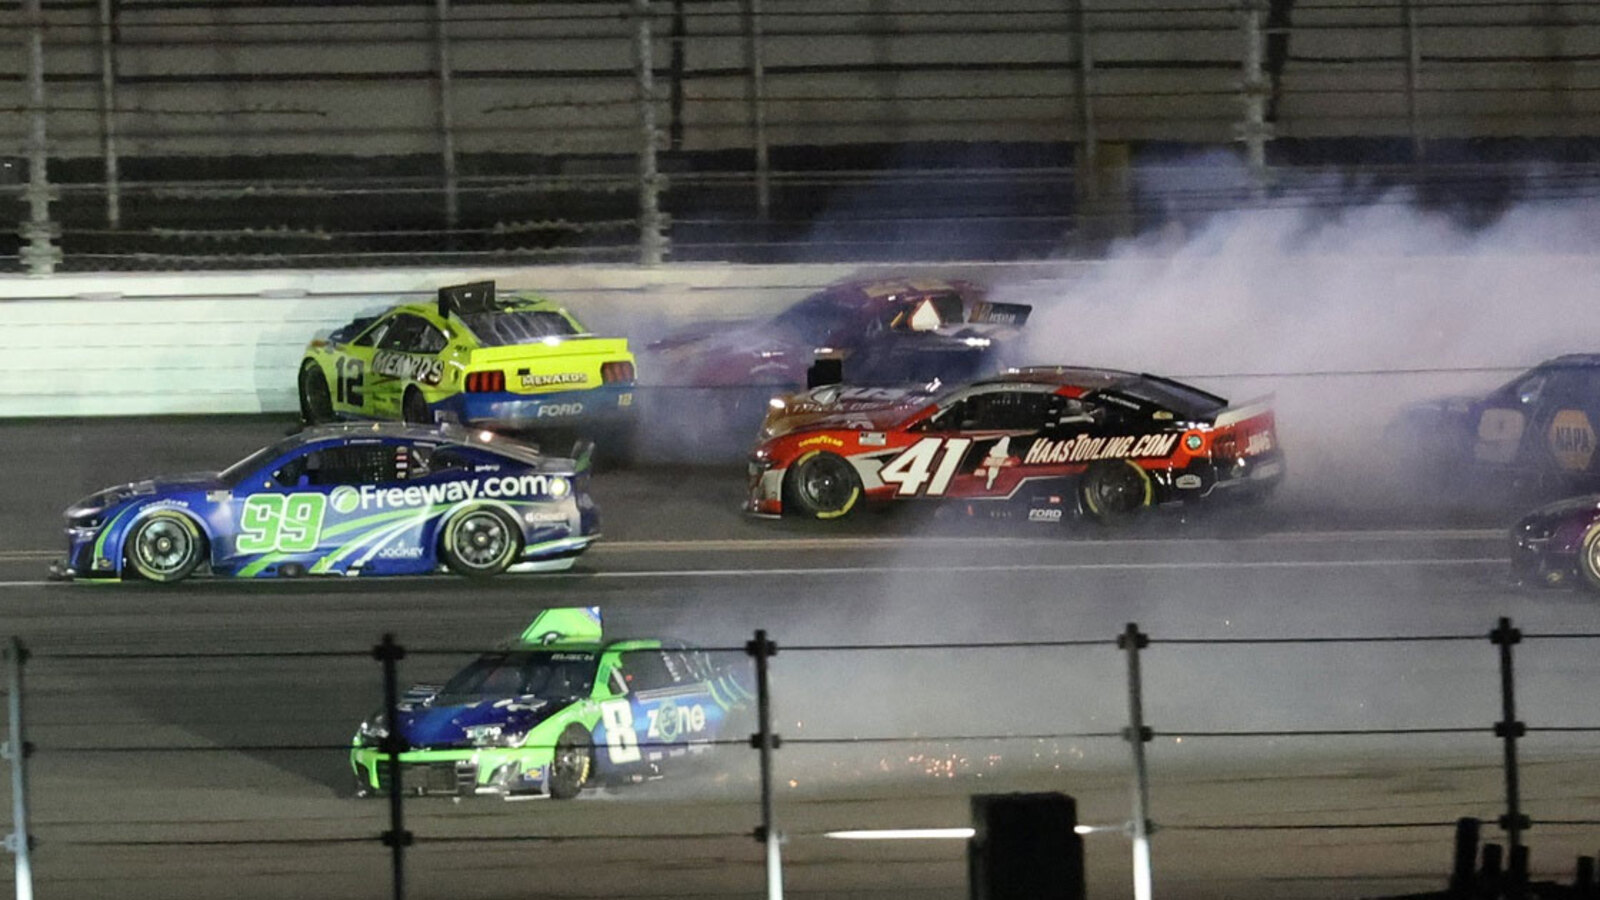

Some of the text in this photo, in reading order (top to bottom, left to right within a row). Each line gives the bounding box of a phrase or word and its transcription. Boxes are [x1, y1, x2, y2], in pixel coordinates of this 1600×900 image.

[335, 355, 364, 407] 12
[522, 373, 587, 386] MENARDS
[537, 403, 583, 417] FORD
[1557, 426, 1590, 452] NAPA
[881, 438, 972, 494] 41
[360, 474, 550, 509] Freeway.com
[236, 493, 326, 552] 99
[1028, 508, 1062, 522] FORD
[378, 546, 424, 558] JOCKEY
[600, 699, 641, 764] 8
[647, 699, 705, 742] zone
